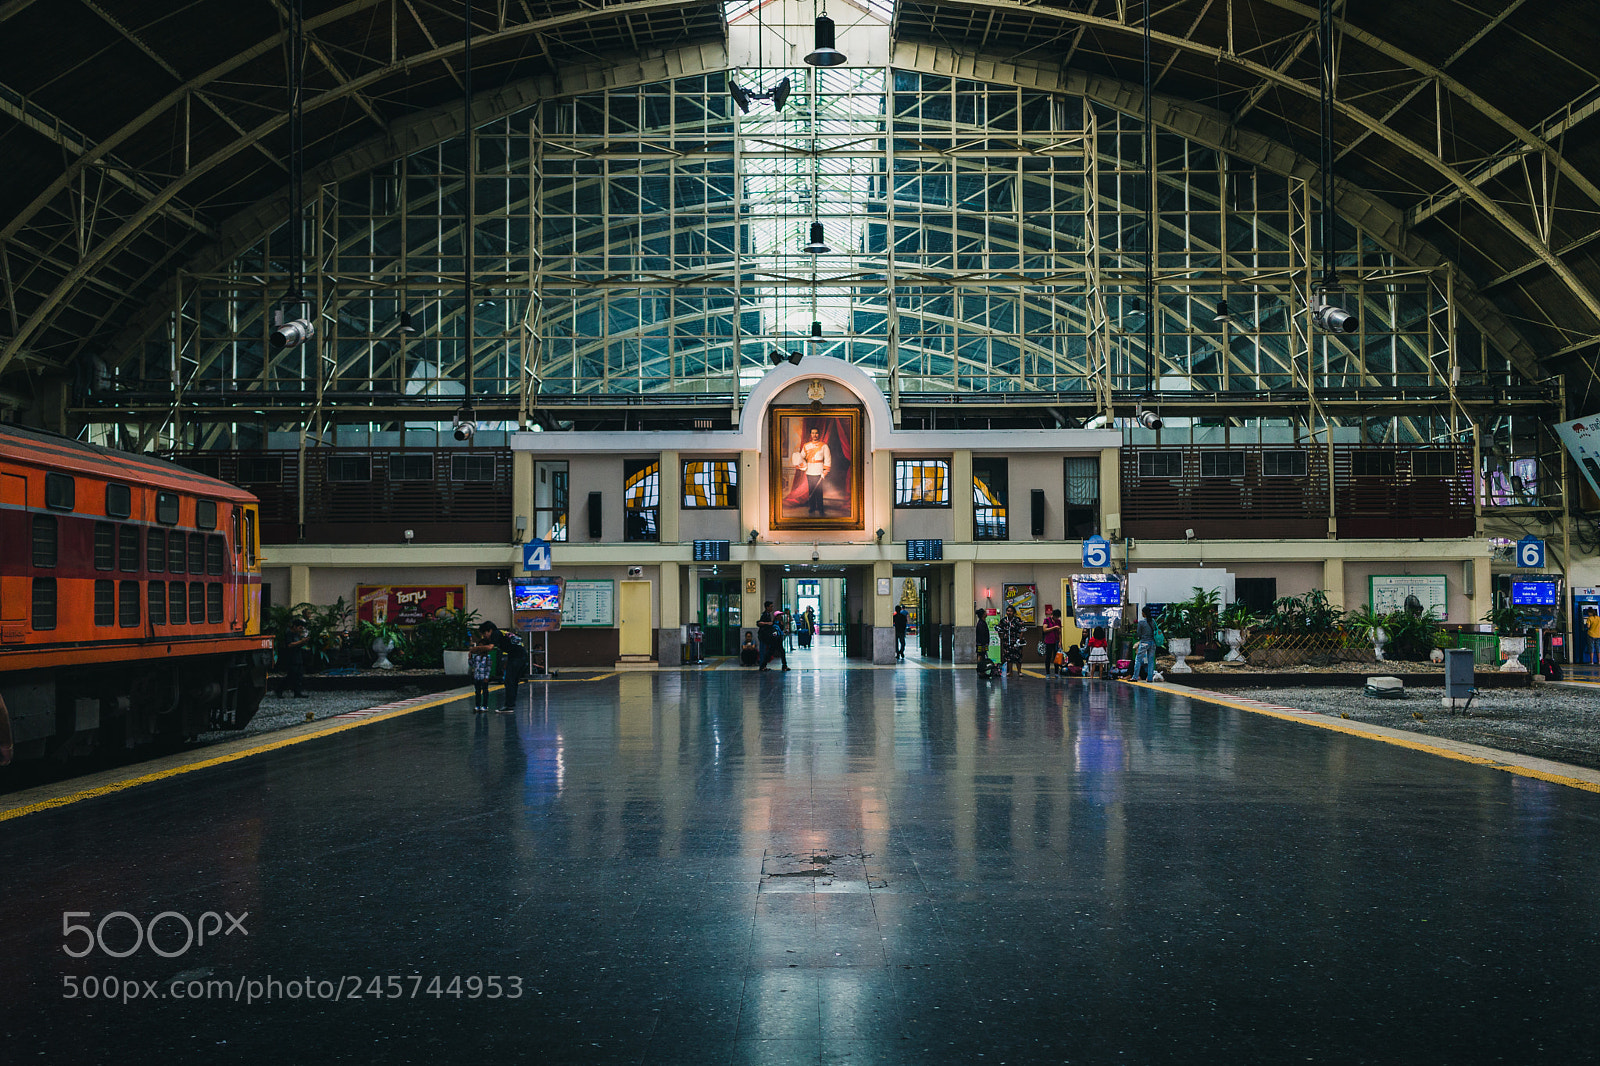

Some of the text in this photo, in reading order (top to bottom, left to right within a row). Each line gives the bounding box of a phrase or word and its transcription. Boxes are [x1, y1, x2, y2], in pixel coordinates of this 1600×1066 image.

[528, 545, 546, 568] 4
[1088, 543, 1106, 565] 5
[1522, 543, 1539, 565] 6
